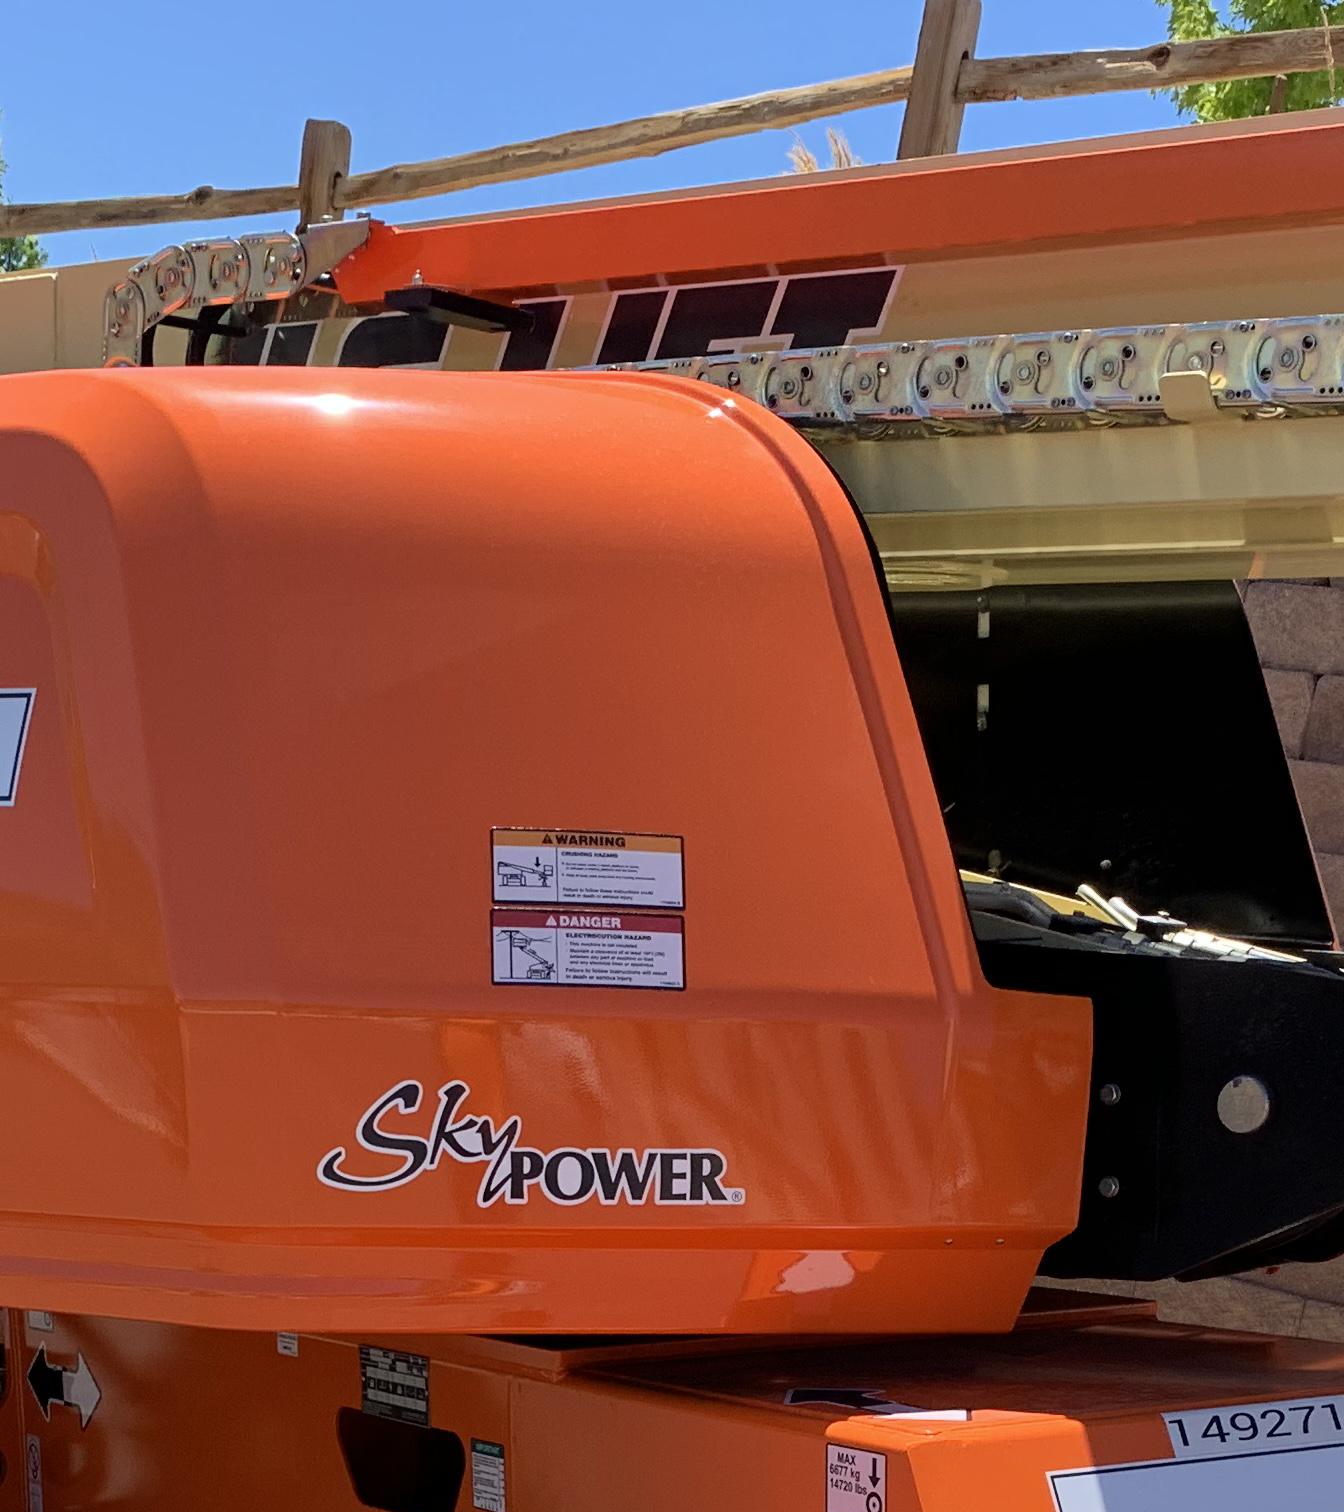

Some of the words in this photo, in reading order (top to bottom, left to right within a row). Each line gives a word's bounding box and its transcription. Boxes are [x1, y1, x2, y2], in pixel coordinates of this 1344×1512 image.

[556, 834, 626, 848] WARNING
[559, 915, 622, 929] DANGER
[321, 1083, 519, 1204] Sky
[509, 1150, 728, 1202] POWER
[1168, 1402, 1343, 1447] 149271
[837, 1451, 856, 1466] MAX
[829, 1463, 849, 1477] 6677
[850, 1467, 861, 1482] kg
[830, 1478, 853, 1493] 14720
[854, 1482, 868, 1496] lbs
